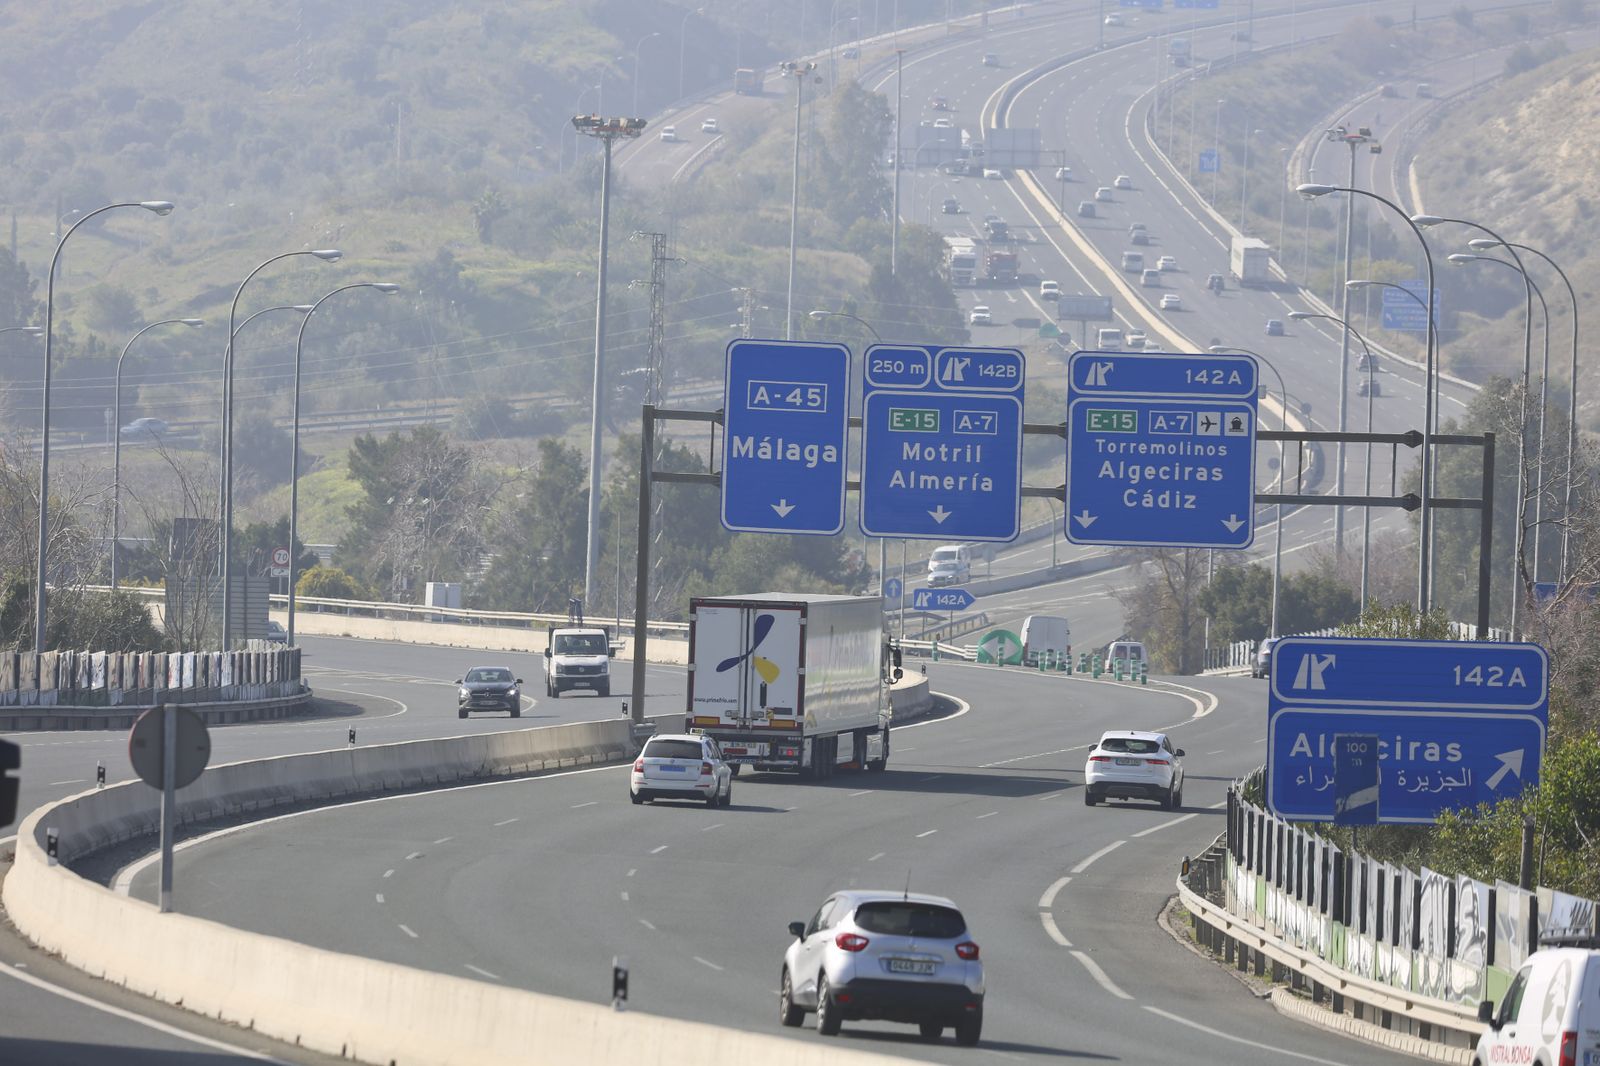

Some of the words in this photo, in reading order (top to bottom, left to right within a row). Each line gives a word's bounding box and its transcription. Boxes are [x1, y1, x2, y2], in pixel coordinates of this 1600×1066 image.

[872, 360, 904, 374] 250
[910, 364, 925, 375] m
[978, 364, 1017, 378] 142B
[1185, 369, 1242, 385] 142A
[753, 386, 821, 407] A-45
[892, 412, 936, 428] E-15
[958, 415, 993, 431] A-7
[1090, 413, 1134, 429] E-15
[1153, 415, 1189, 431] A-7
[732, 435, 837, 468] Málaga
[902, 442, 982, 463] Motril
[1095, 439, 1228, 456] Torremolinos
[1098, 460, 1223, 484] Algeciras
[889, 470, 993, 492] Almería
[1123, 489, 1197, 509] Cádiz
[277, 553, 288, 561] 70
[936, 594, 967, 605] 142A
[1453, 665, 1527, 688] 142A
[1289, 732, 1462, 762] Alciras
[1346, 743, 1368, 753] 100
